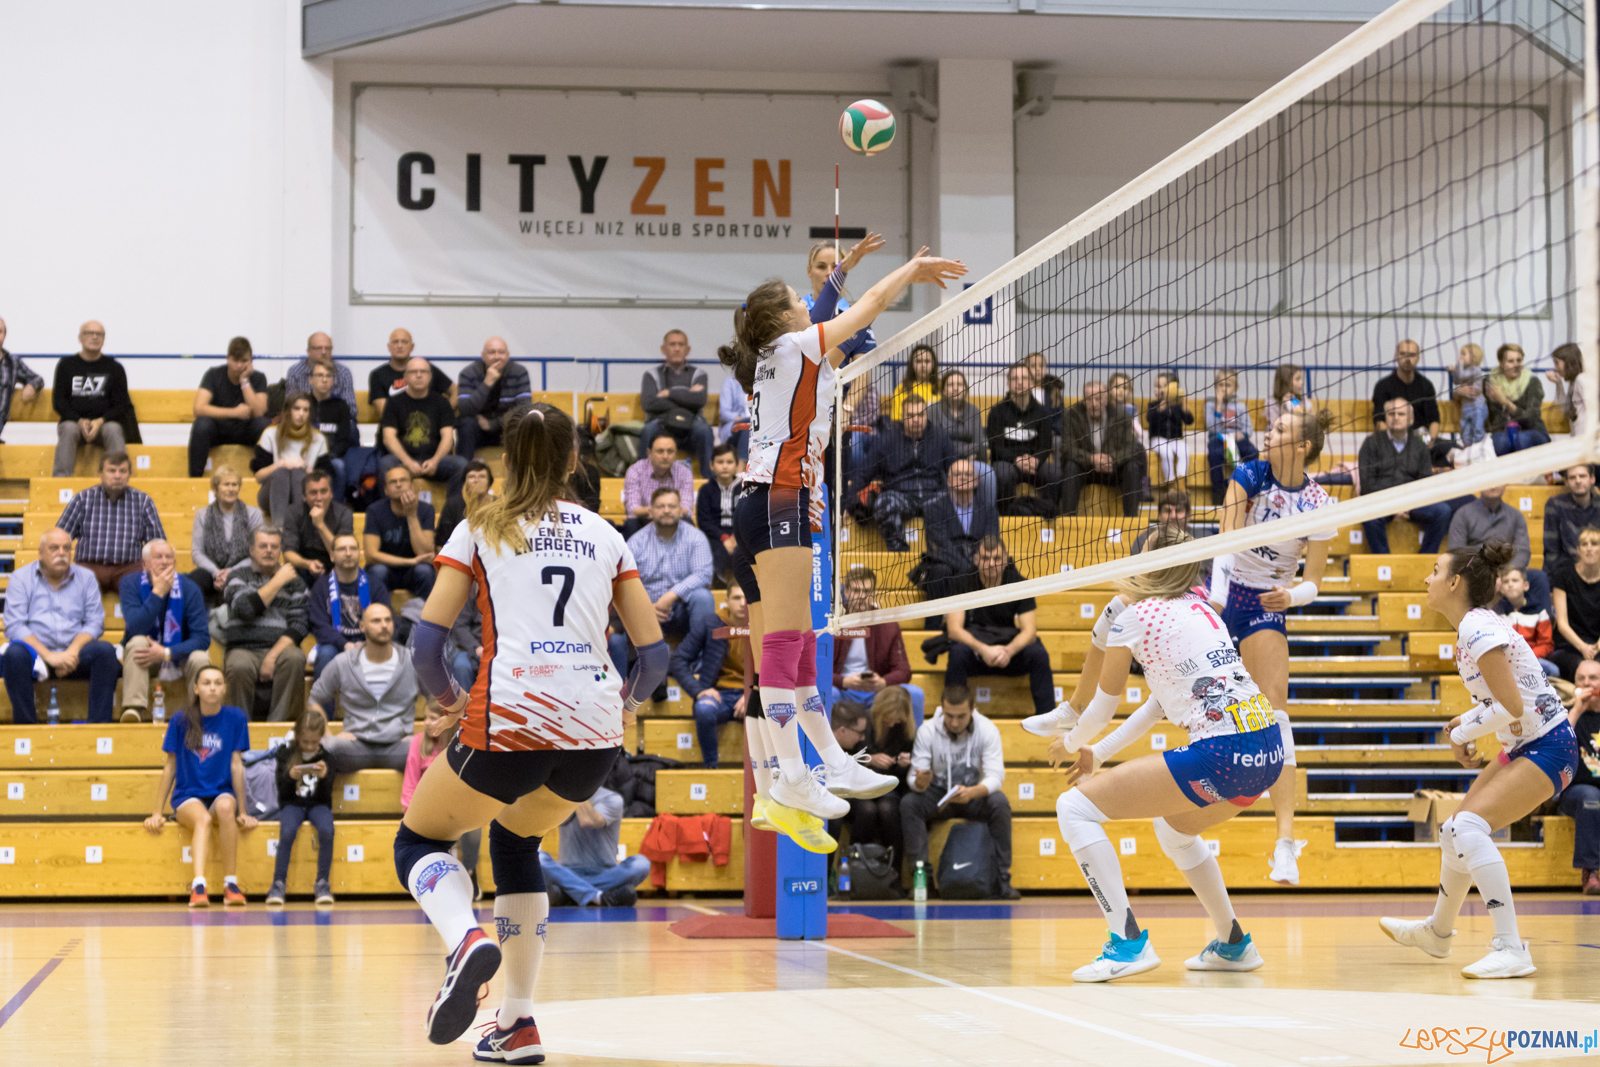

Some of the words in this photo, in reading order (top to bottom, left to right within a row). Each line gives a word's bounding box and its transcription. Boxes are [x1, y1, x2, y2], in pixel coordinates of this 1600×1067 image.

[396, 150, 792, 218] CITYZEN
[519, 220, 584, 238] WIĘCEJ
[635, 222, 681, 237] KLUB
[692, 223, 792, 239] SPORTOWY
[72, 376, 105, 391] EA7
[538, 527, 573, 538] ENEA
[780, 521, 790, 535] 3
[812, 556, 822, 602] Senoh
[541, 566, 575, 627] 7
[1190, 603, 1220, 630] 1
[842, 627, 867, 636] Senoh
[1174, 658, 1199, 676] SOFA
[1233, 744, 1284, 768] redruk
[1023, 786, 1031, 794] 12
[1124, 841, 1132, 849] 11
[1088, 877, 1113, 913] COMPRESSION
